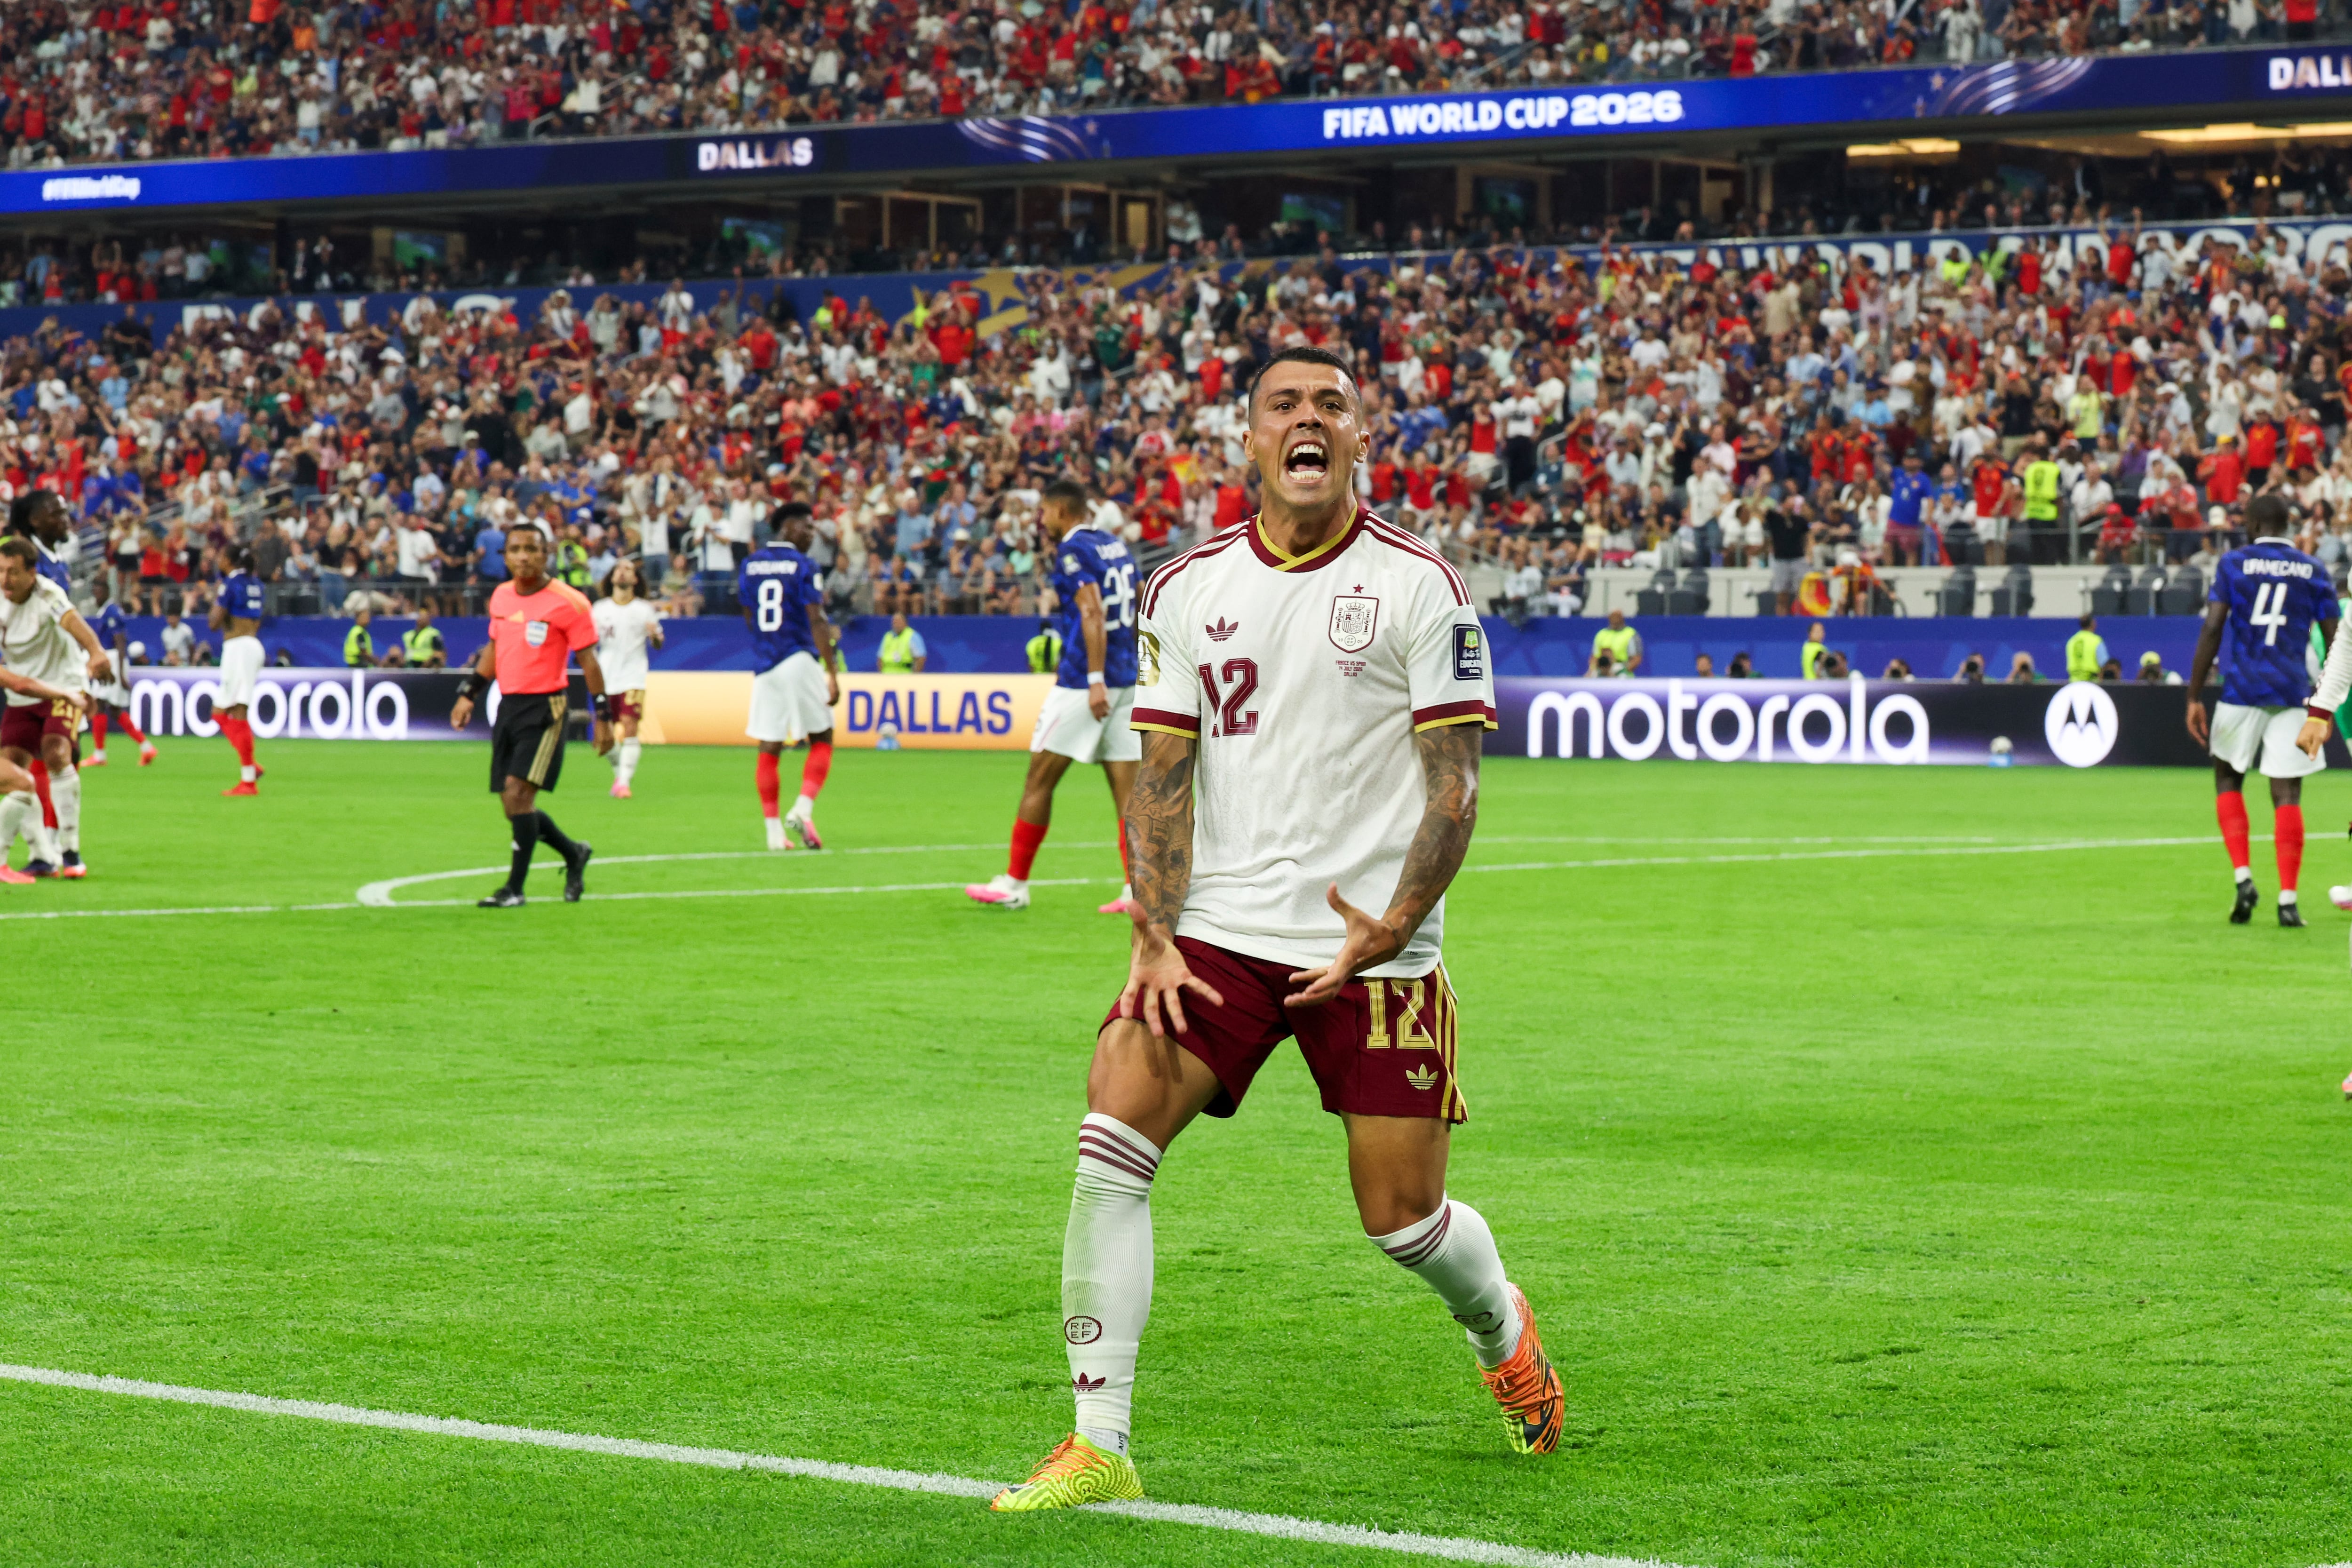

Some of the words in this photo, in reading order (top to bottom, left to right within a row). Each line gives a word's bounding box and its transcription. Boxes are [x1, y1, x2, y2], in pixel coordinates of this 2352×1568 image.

[1323, 106, 1390, 139] FIFA
[1390, 100, 1503, 135] WORLD
[1504, 96, 1569, 130] CUP
[1570, 90, 1683, 126] 2026
[698, 137, 814, 171] DALLAS
[758, 579, 783, 632] 8
[2249, 582, 2287, 646] 4
[130, 668, 408, 740] moorola
[848, 690, 1012, 735] DALLAS
[1198, 658, 1258, 738] 12
[1527, 678, 1930, 764] motorola
[1363, 978, 1435, 1049] 12
